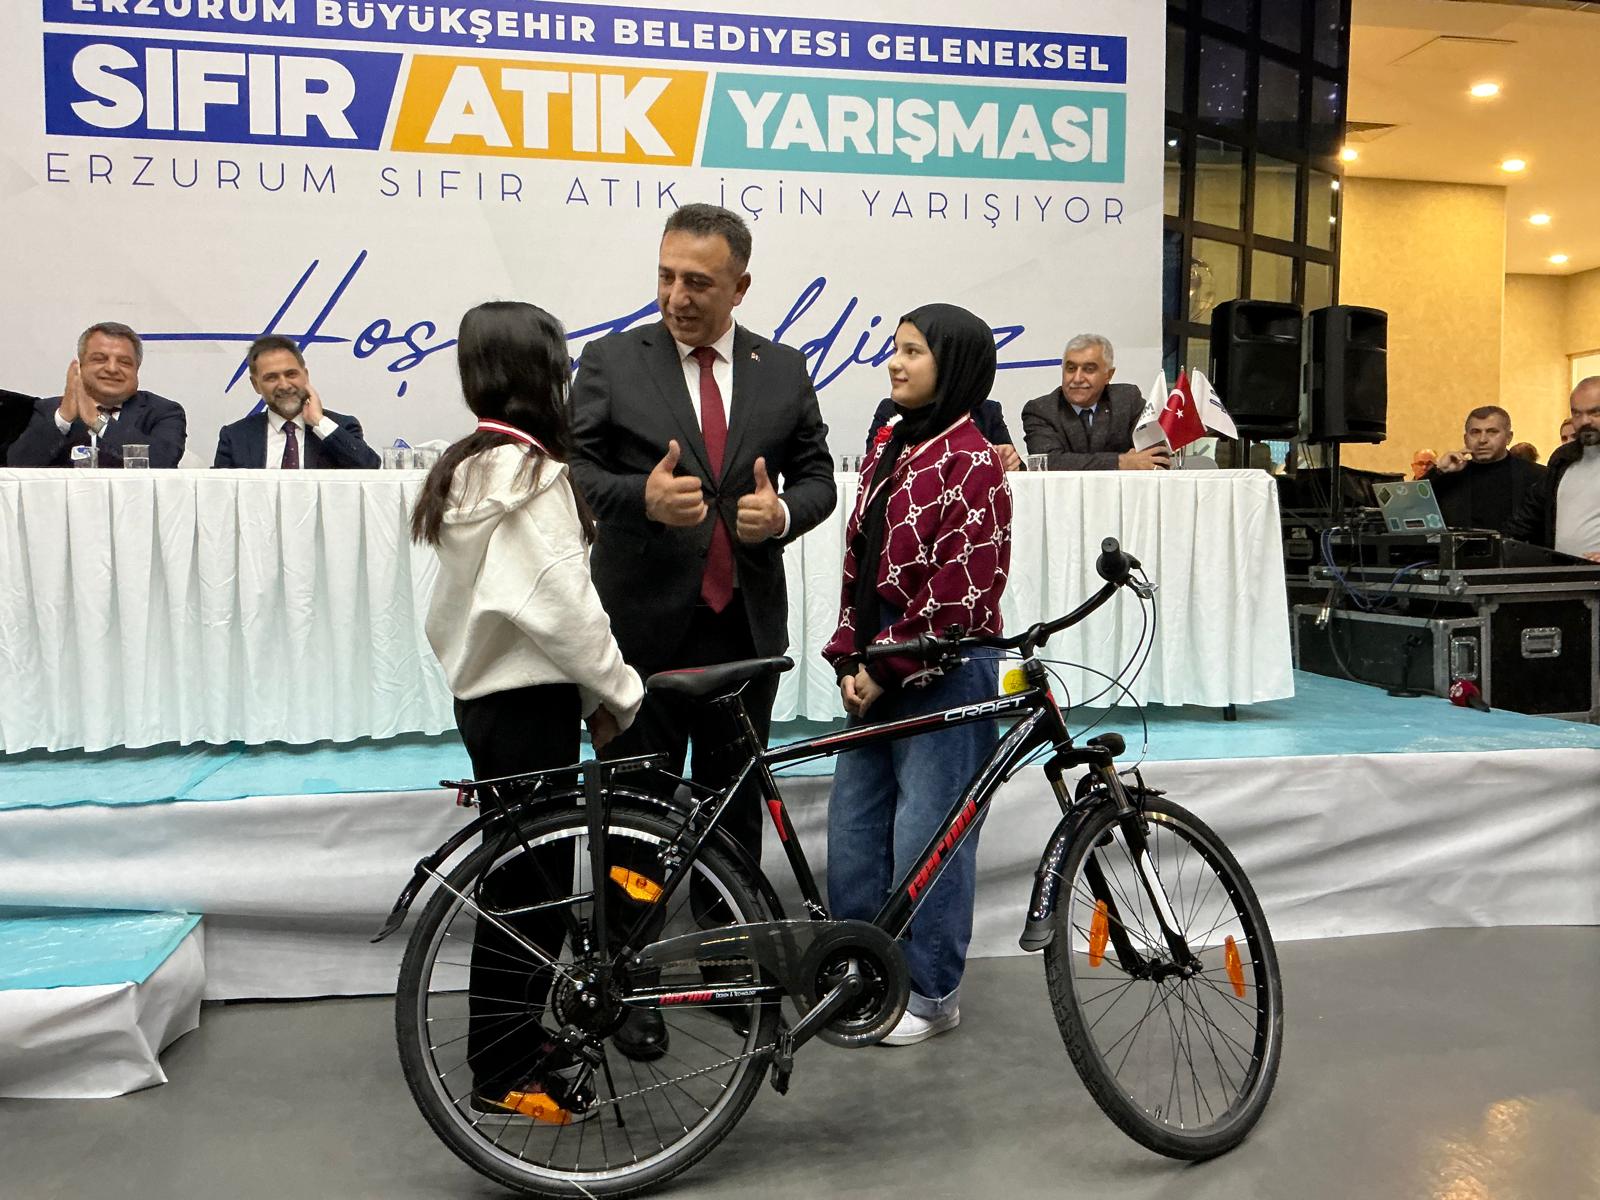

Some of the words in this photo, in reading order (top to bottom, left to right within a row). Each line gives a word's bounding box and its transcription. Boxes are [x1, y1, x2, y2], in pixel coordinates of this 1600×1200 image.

[316, 3, 596, 44] BÜYÜKŞEHİR
[613, 18, 851, 58] BELEDİYESİ
[867, 33, 1109, 72] GELENEKSEL
[70, 43, 359, 140] SIFIR
[425, 65, 675, 157] ATIK
[727, 89, 1109, 163] YARIŞMASI
[47, 152, 336, 194] ERZURUM
[379, 167, 525, 202] SIFIR
[566, 177, 680, 208] ATIK
[719, 177, 823, 221] İÇİN
[861, 189, 1124, 229] YARIŞIYOR
[944, 696, 1025, 721] CRAFT
